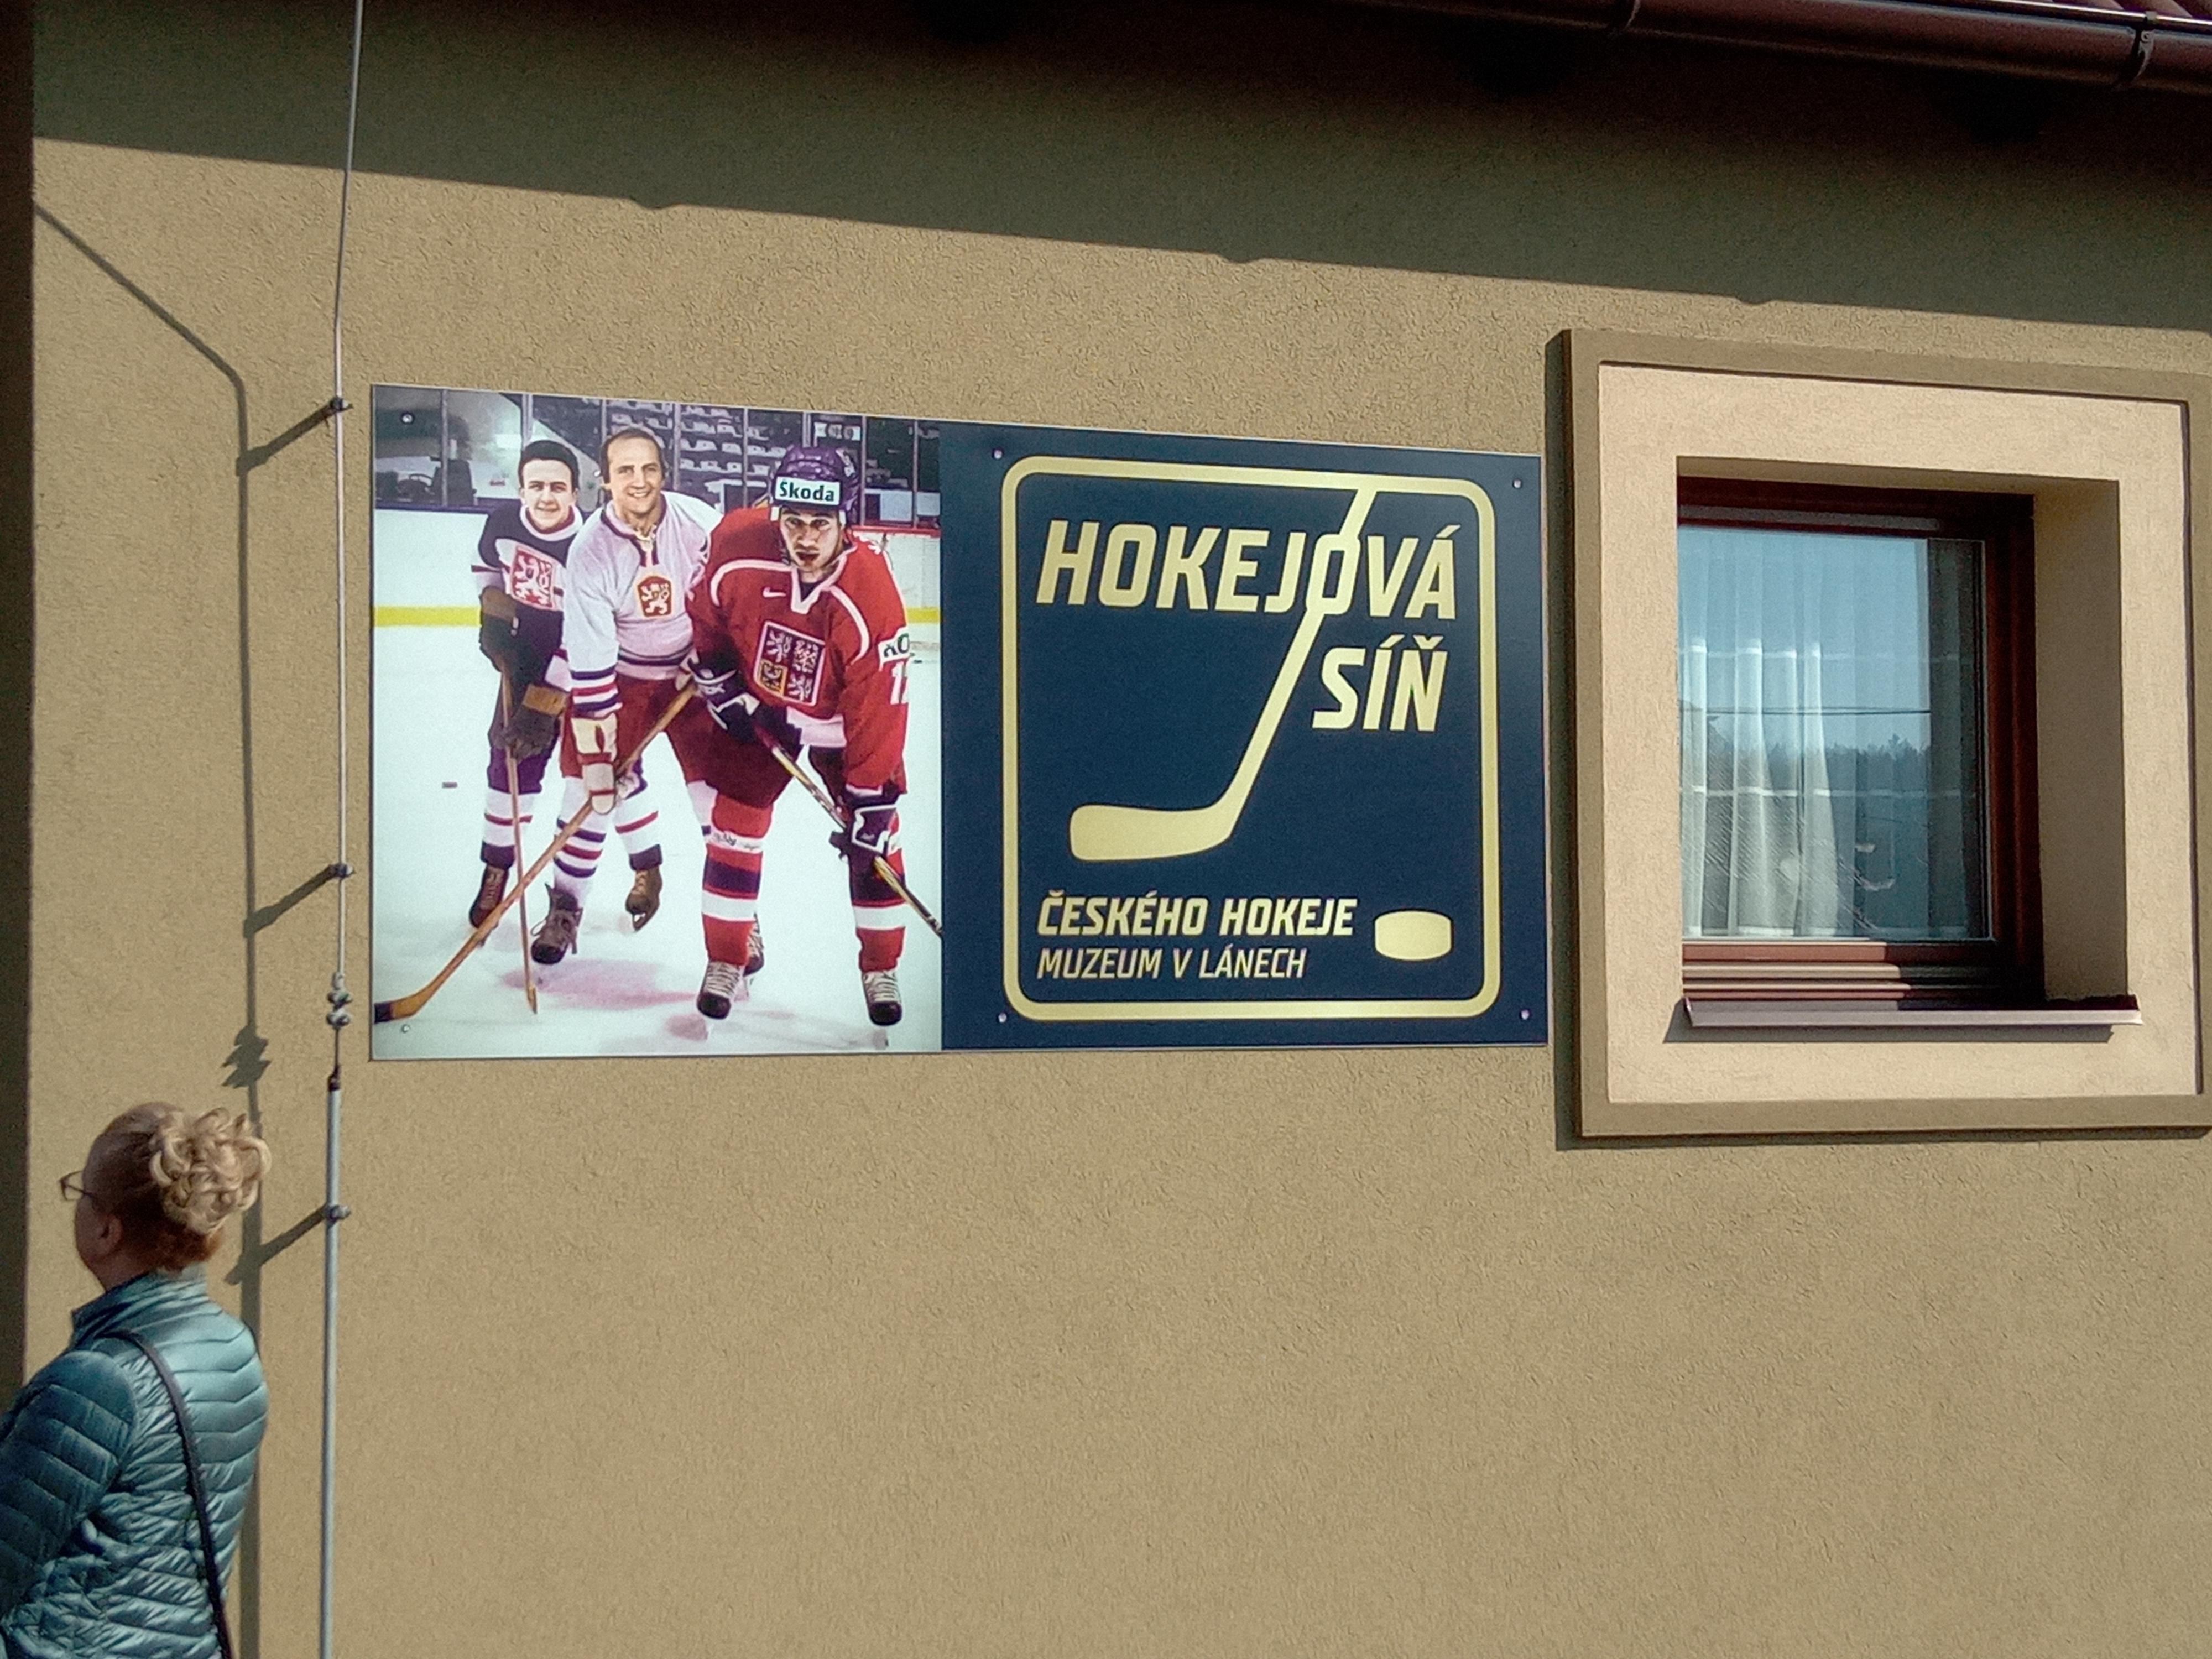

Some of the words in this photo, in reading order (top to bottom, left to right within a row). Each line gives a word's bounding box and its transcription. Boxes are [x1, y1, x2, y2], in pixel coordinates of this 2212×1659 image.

[1036, 520, 1460, 619] HOKEJOVÁ
[1312, 634, 1448, 732] SÍŇ
[1037, 890, 1209, 936] ČESKÉHO
[1219, 898, 1358, 936] HOKEJE
[1037, 948, 1162, 979] MUZEUM
[1173, 948, 1193, 979] V
[1198, 943, 1307, 979] LÁNECH
